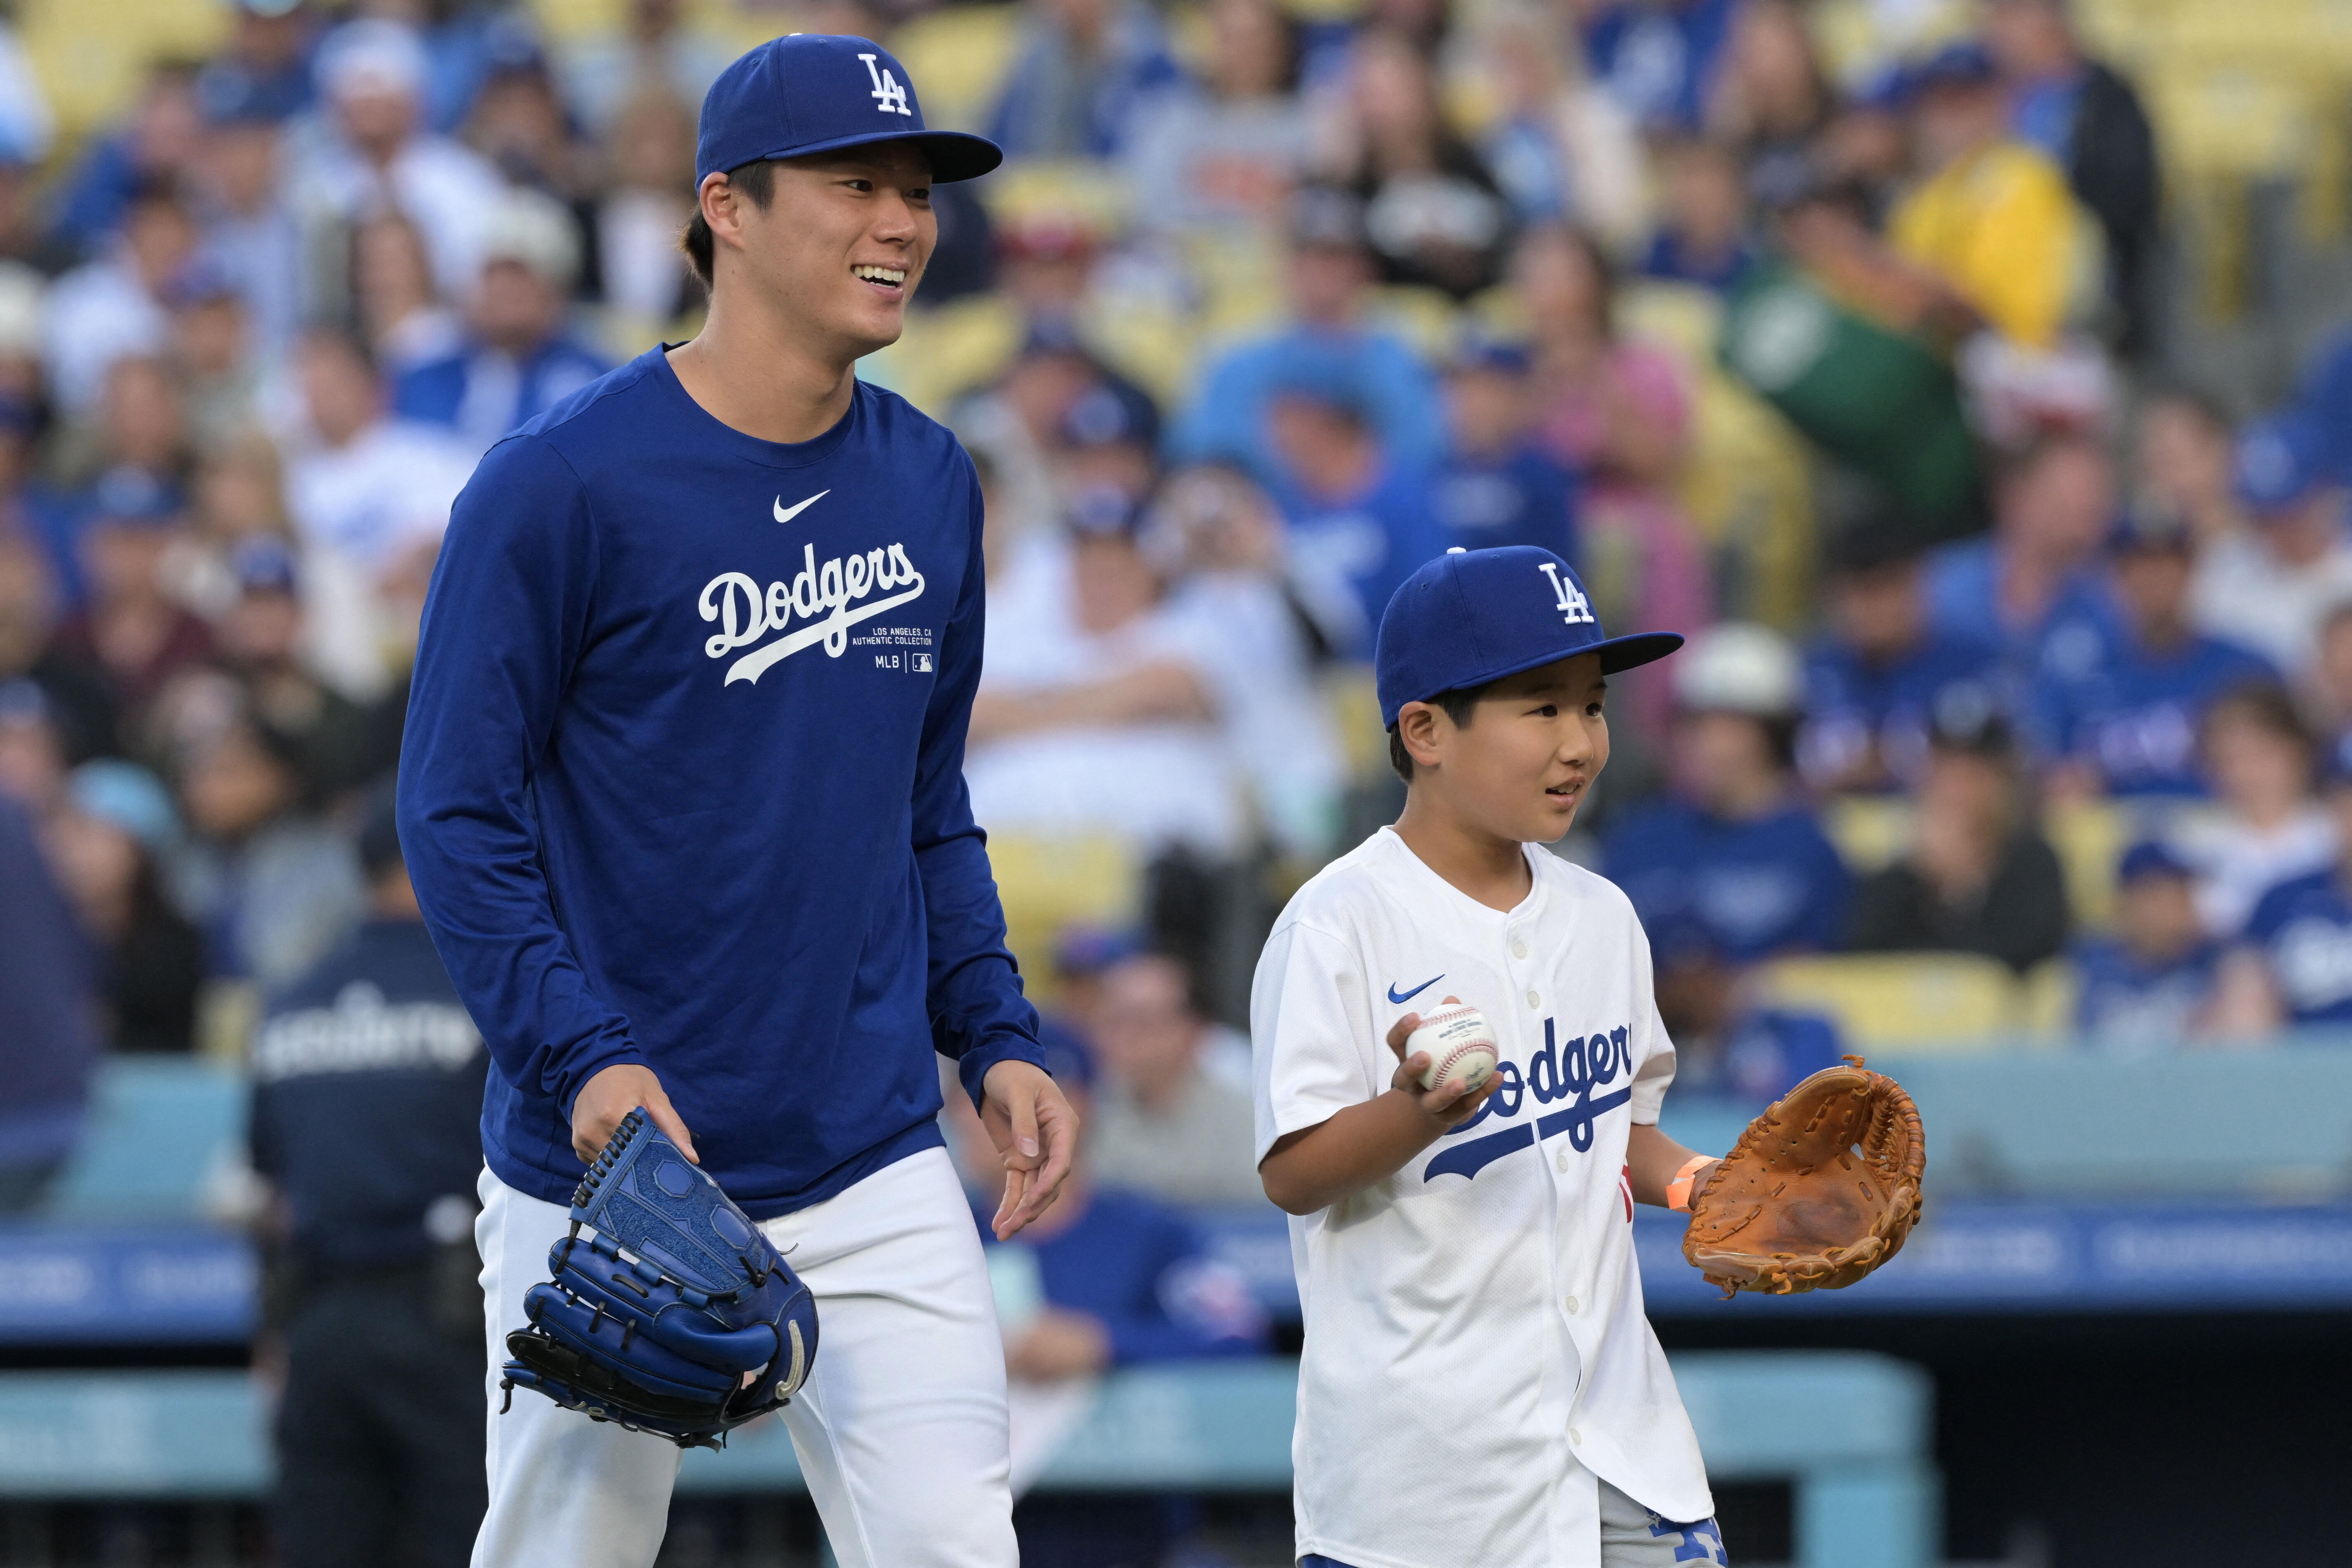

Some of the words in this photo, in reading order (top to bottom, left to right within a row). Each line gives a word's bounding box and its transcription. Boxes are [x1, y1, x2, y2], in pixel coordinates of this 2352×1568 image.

[857, 54, 911, 117] LA
[698, 542, 925, 687] Dodgers
[1538, 563, 1594, 624] LA
[852, 636, 892, 645] AUTHENTIC
[895, 637, 932, 645] COLLECTION
[875, 655, 899, 668] MLB
[890, 628, 923, 636] ANGELES,
[1392, 1017, 1632, 1183] odger
